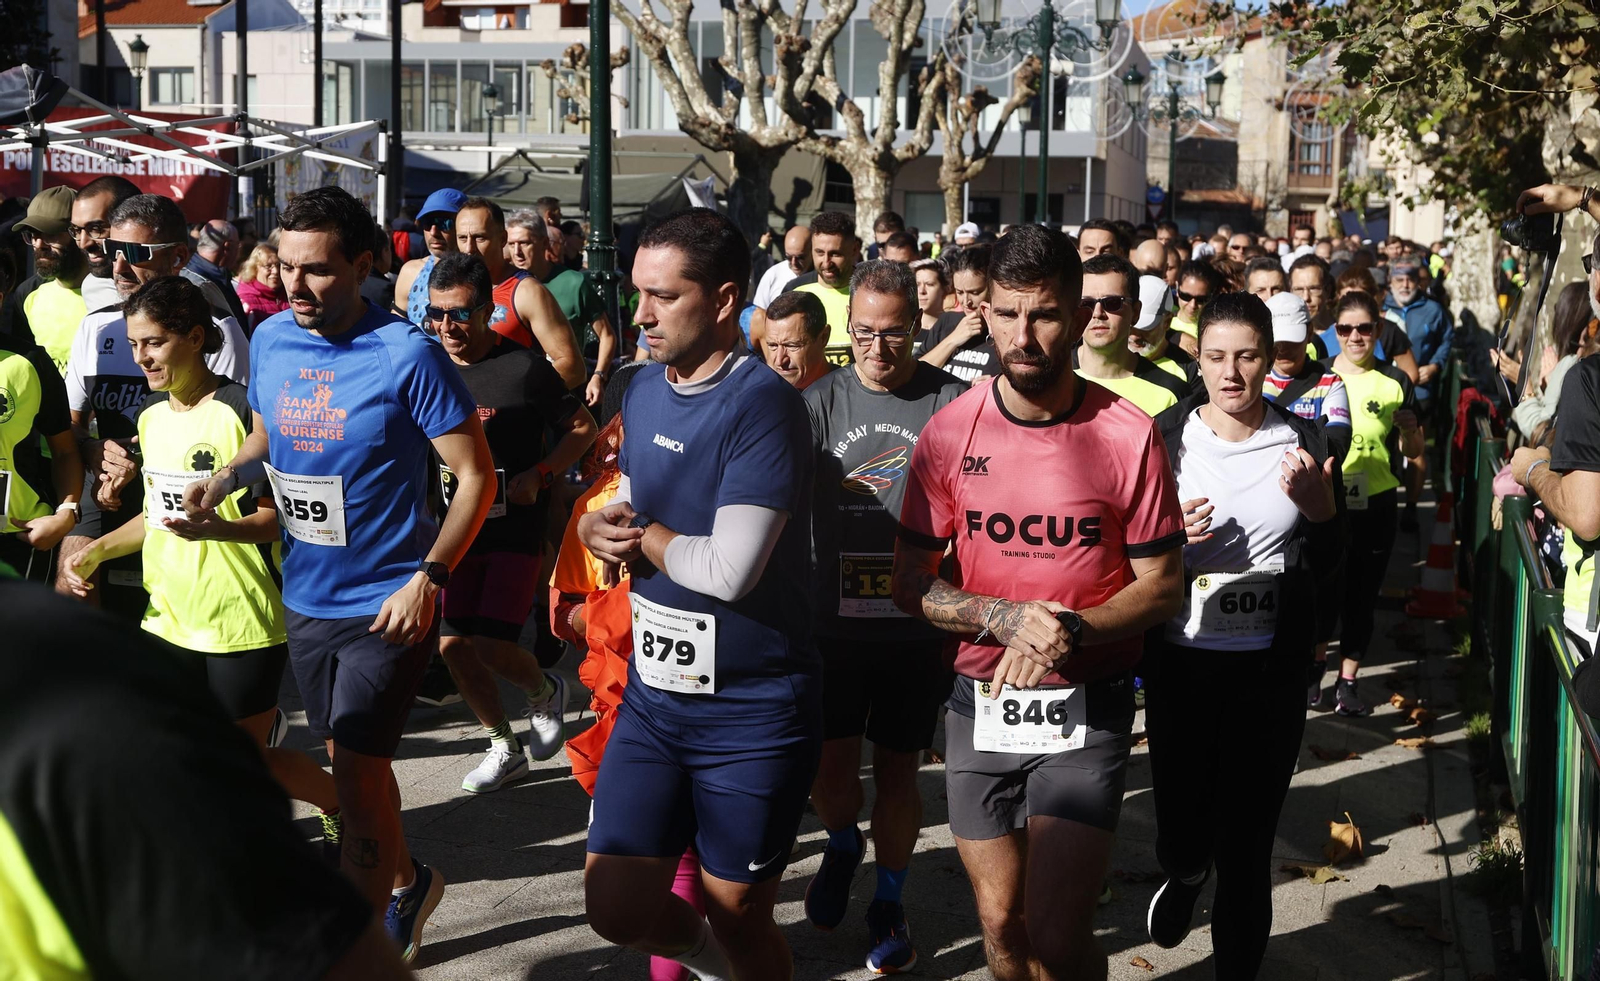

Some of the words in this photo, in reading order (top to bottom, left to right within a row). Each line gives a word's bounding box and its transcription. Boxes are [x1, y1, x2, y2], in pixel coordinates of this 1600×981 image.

[51, 153, 146, 175] ESCLEROSE
[952, 349, 990, 366] ANCRO
[299, 368, 335, 382] XLVII
[283, 396, 313, 411] SAN
[280, 425, 345, 440] OURENSE
[832, 424, 867, 458] VIG-BAY
[874, 423, 901, 435] MEDIO
[293, 440, 324, 453] 2024
[652, 433, 684, 454] ABANCA
[962, 455, 992, 472] DK
[282, 495, 328, 523] 859
[965, 509, 1102, 548] FOCUS
[1001, 550, 1030, 558] TRAINING
[1033, 552, 1056, 560] STUDIO
[859, 574, 892, 596] 13
[1220, 590, 1275, 615] 604
[642, 630, 696, 666] 879
[1002, 699, 1068, 726] 846
